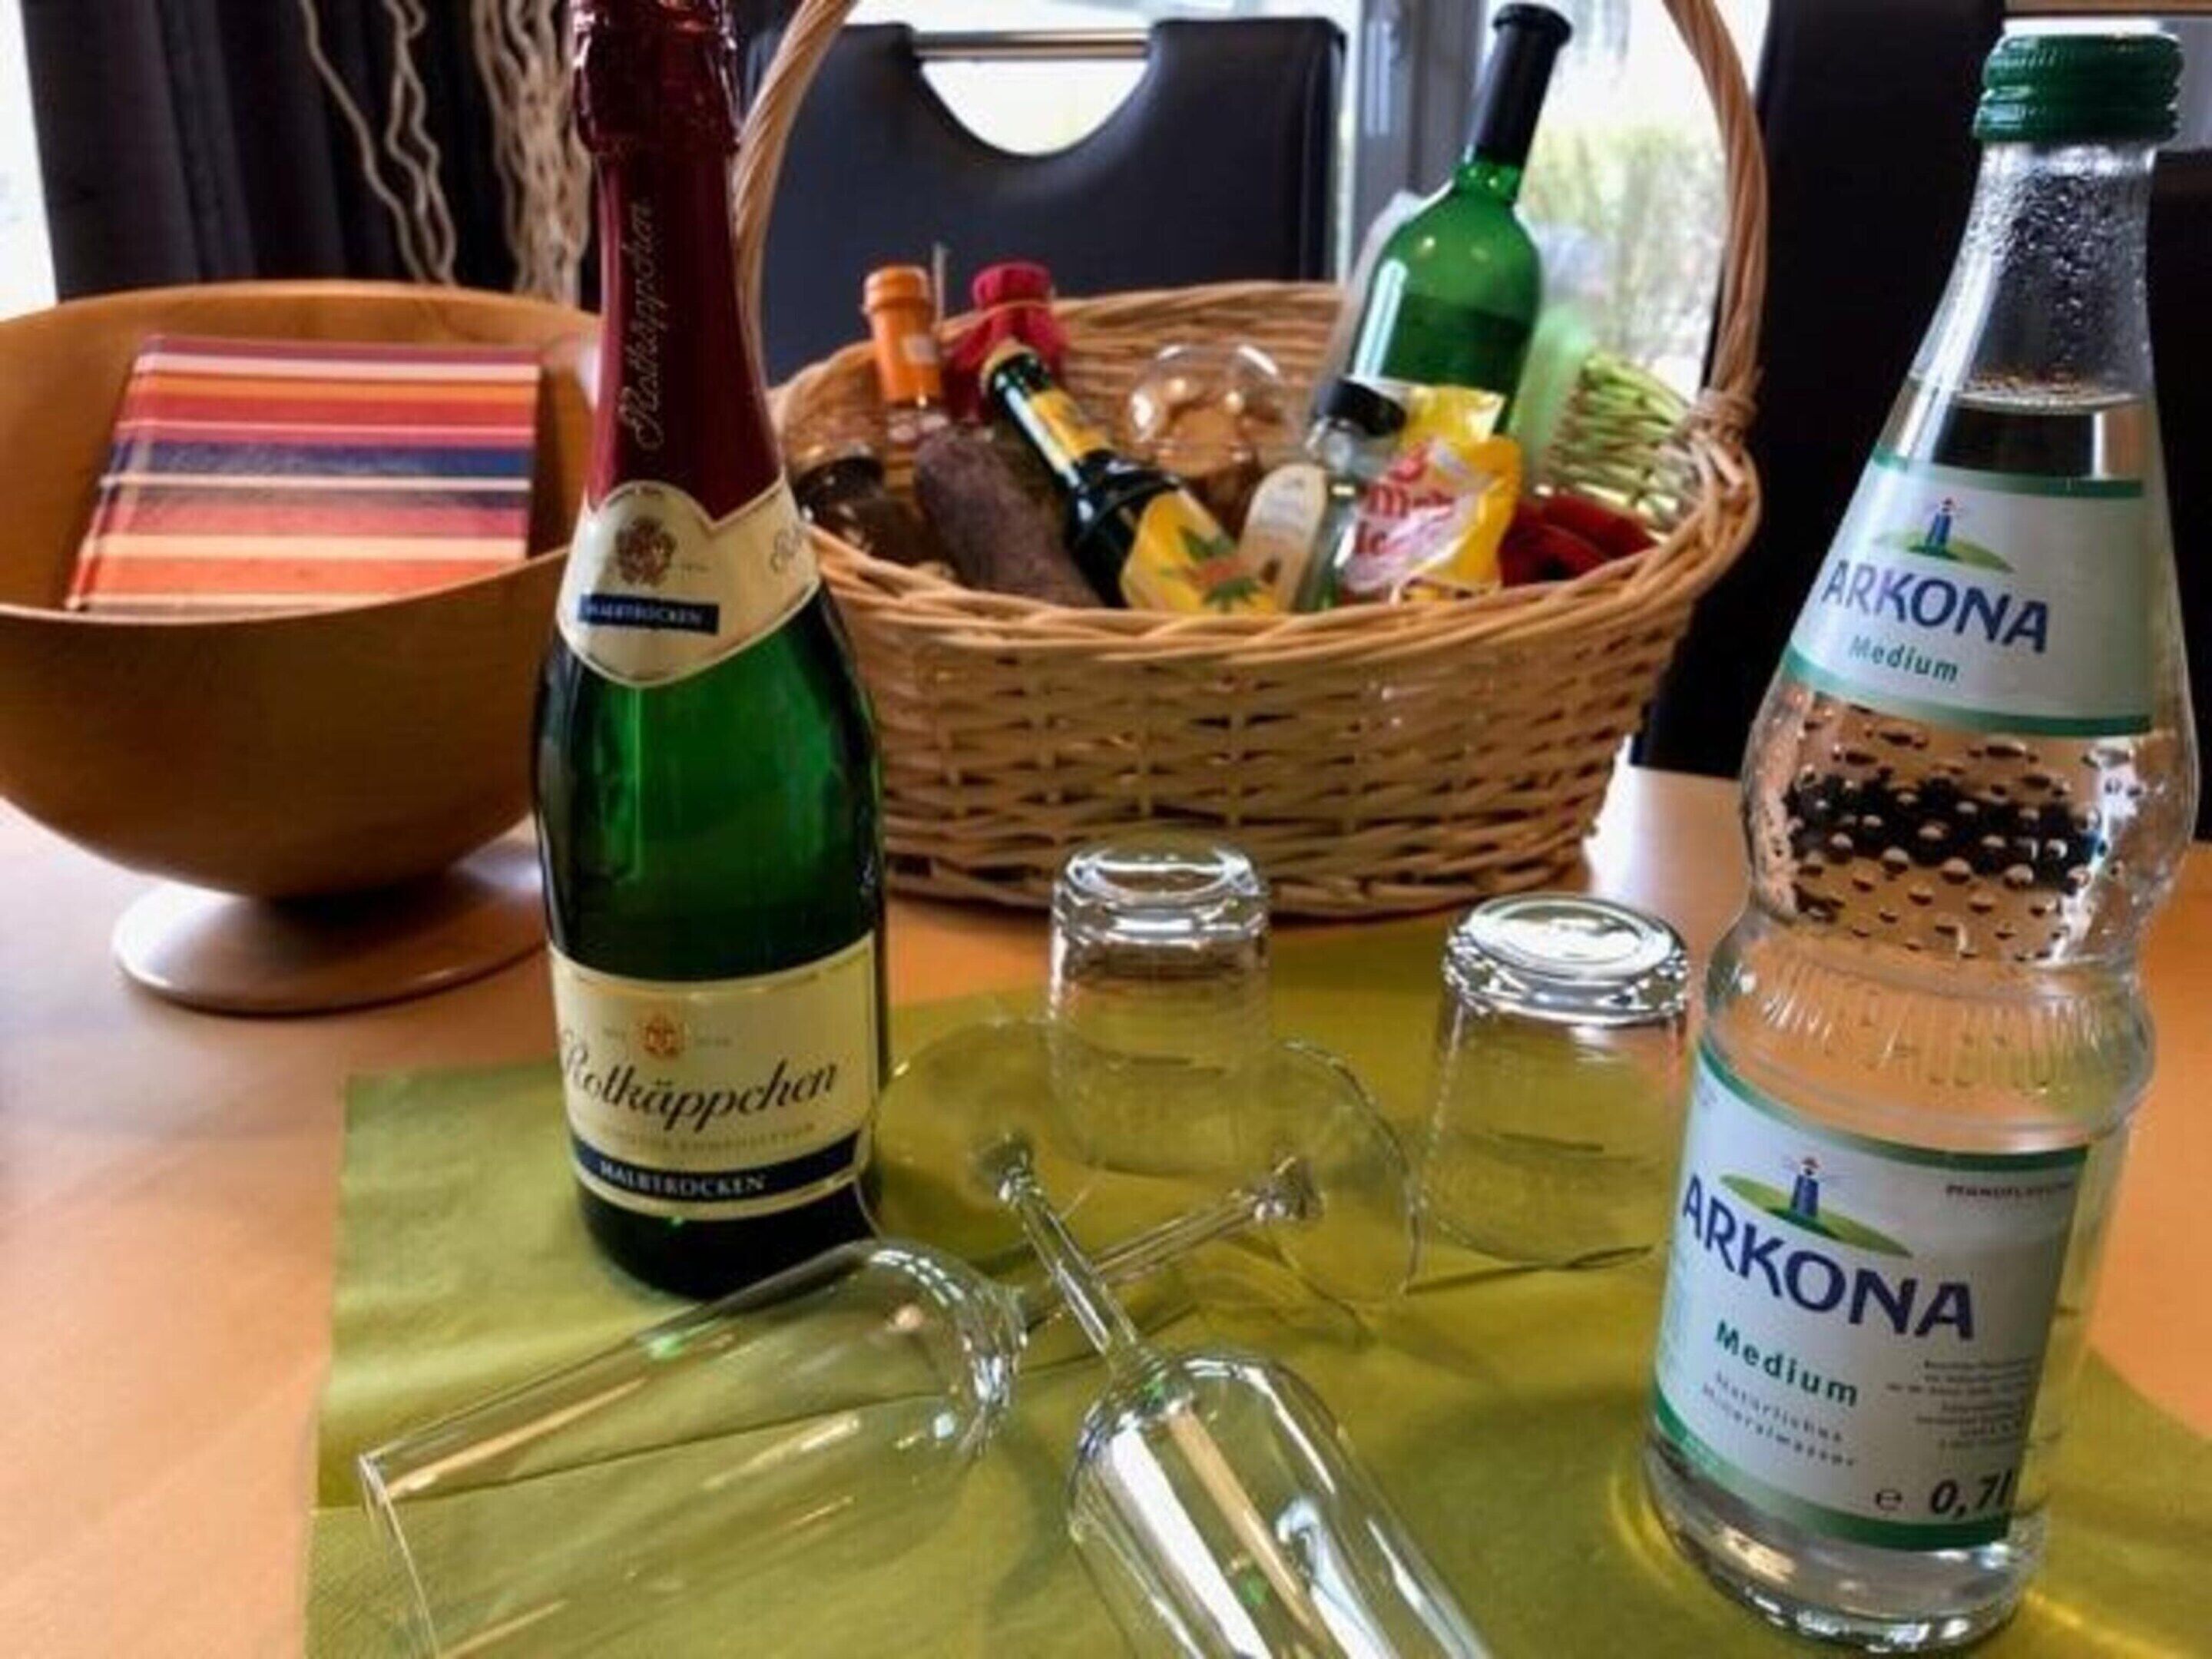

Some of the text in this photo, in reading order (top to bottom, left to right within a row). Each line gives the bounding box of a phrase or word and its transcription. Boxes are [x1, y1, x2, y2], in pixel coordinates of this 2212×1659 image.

[1821, 559, 2048, 654] ARKONA
[1848, 635, 1959, 683] Medium
[565, 1034, 839, 1134] Rotkäppchen
[599, 1158, 767, 1197] HALBTROCKEN
[1683, 1174, 1974, 1340] ARKONA
[1716, 1320, 1857, 1408] Medium
